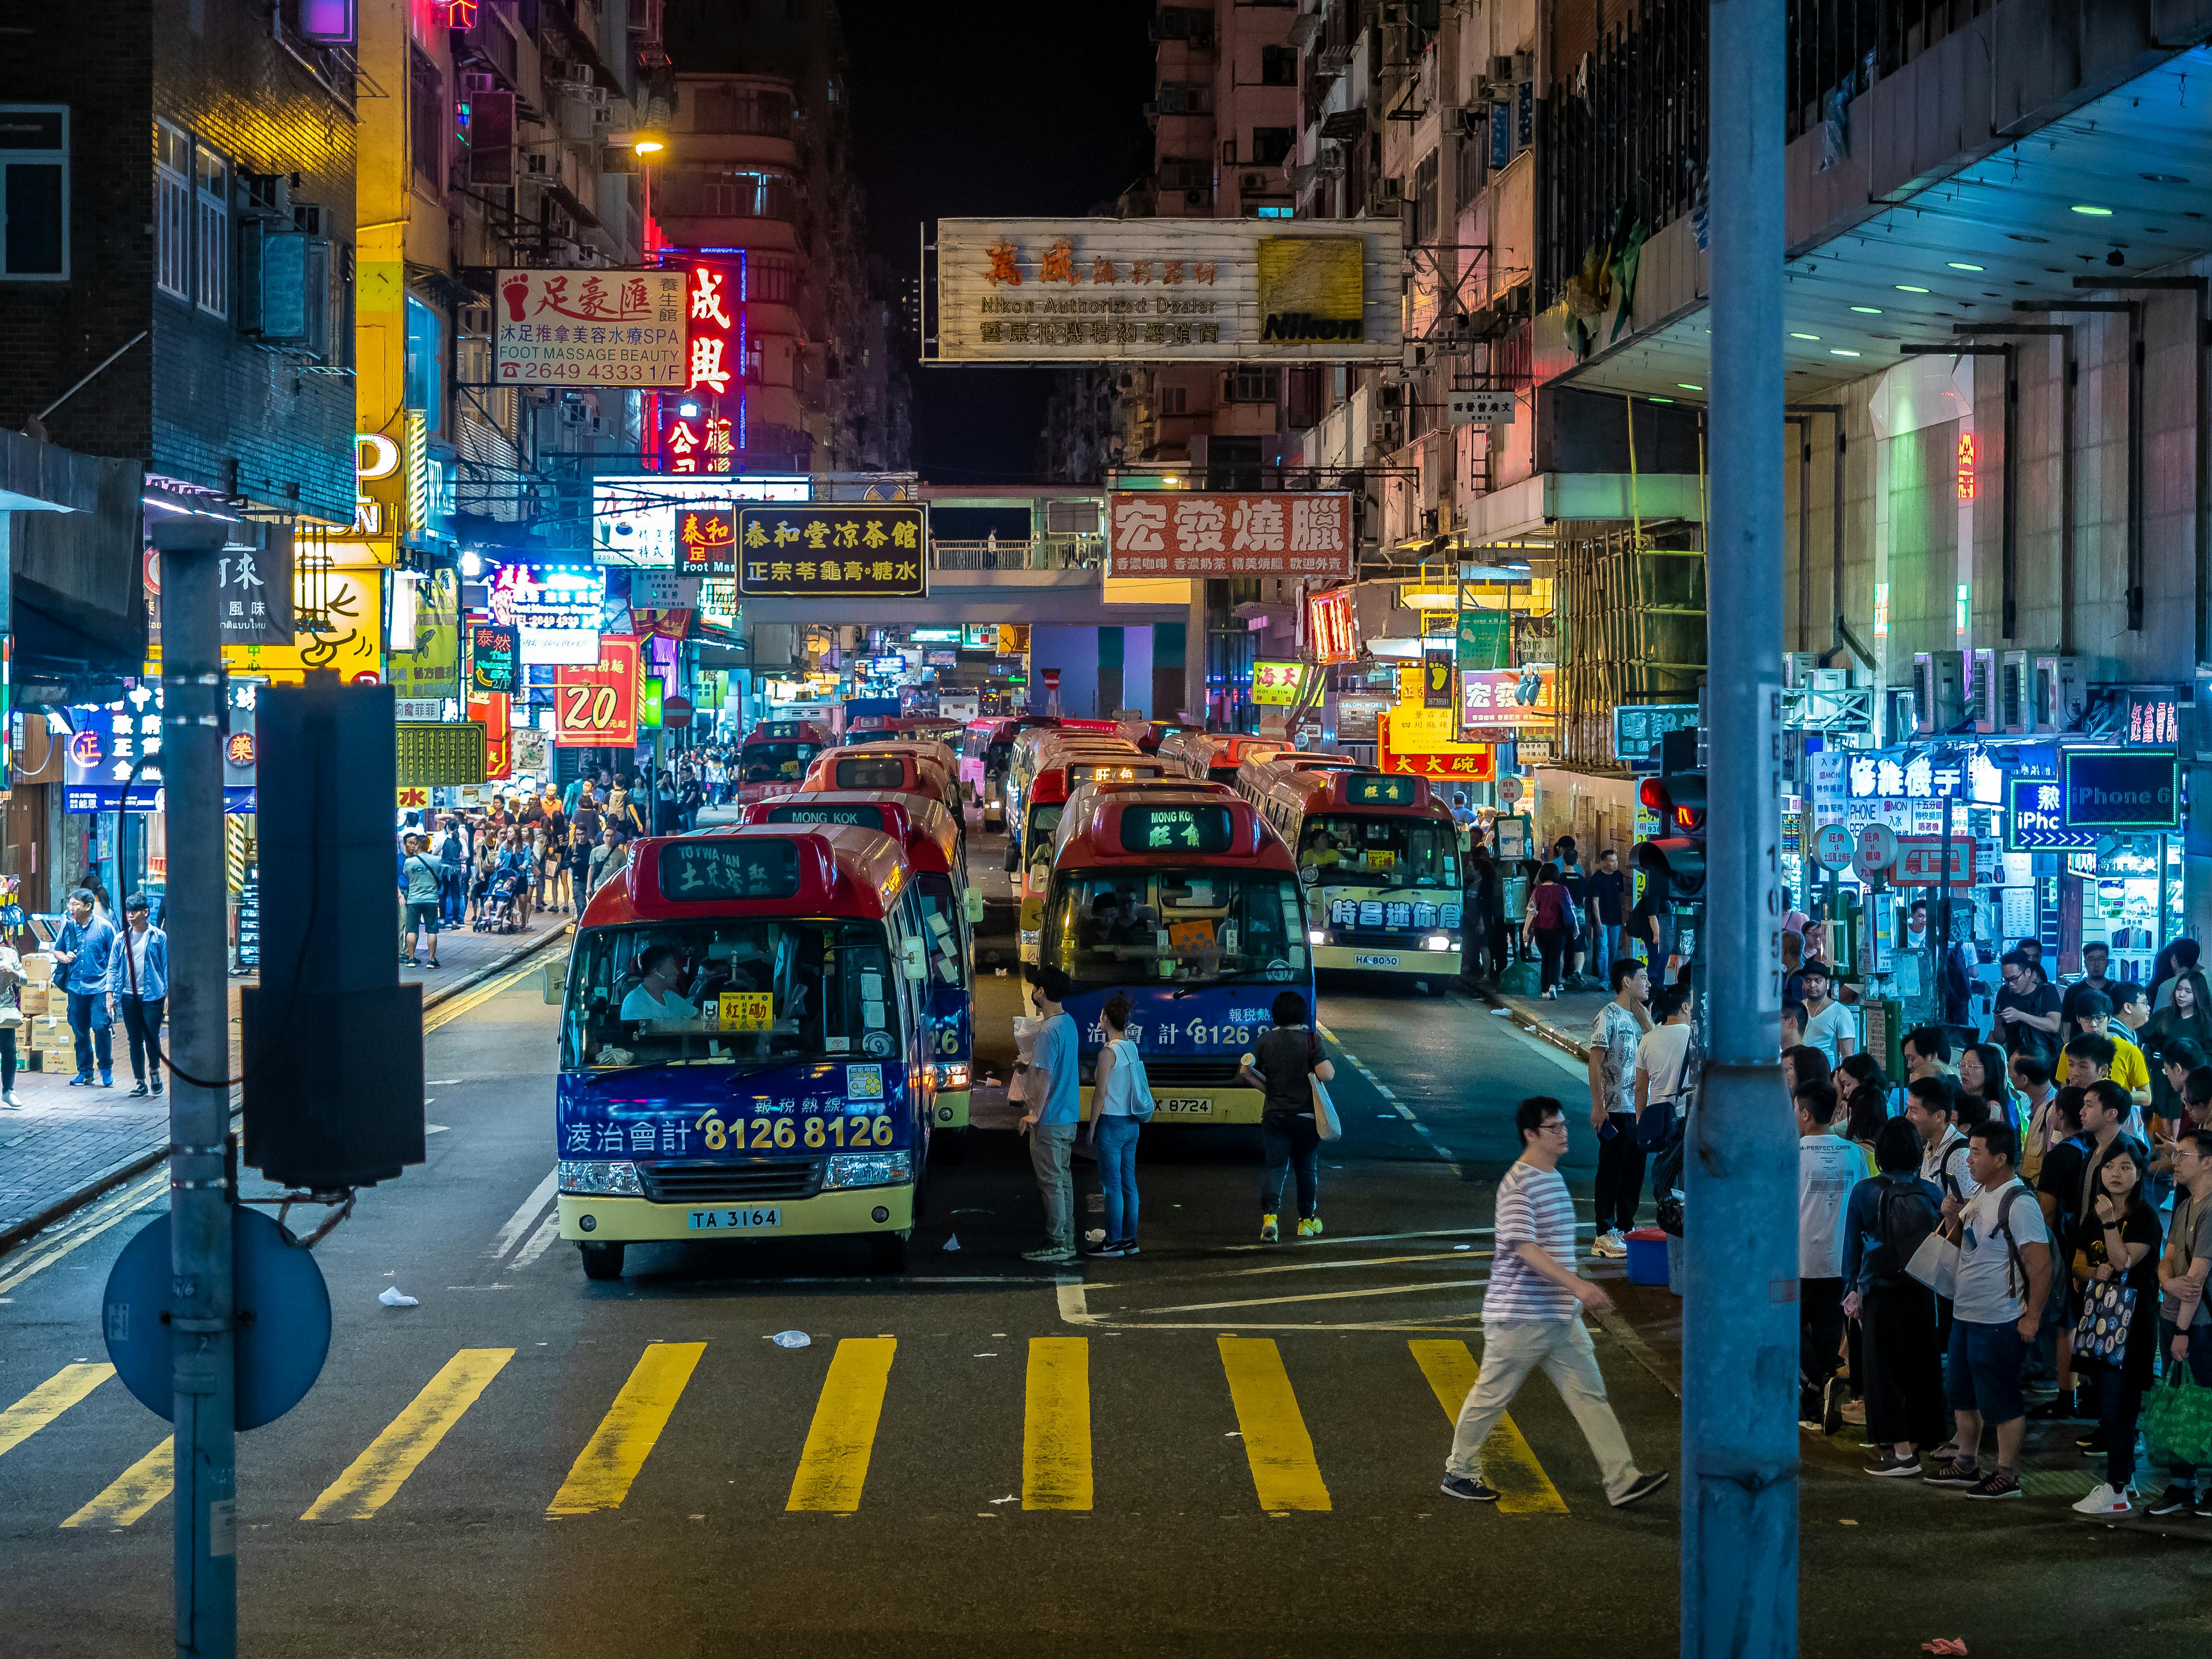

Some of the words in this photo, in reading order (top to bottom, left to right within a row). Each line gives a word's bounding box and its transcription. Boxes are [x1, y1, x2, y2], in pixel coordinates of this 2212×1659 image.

[659, 278, 678, 322] 養生館
[981, 297, 1034, 314] Nikon
[1044, 296, 1146, 314] Authorized
[1156, 297, 1216, 314] Dealer
[1263, 312, 1361, 340] Nikon
[500, 346, 539, 359] FOOT
[544, 348, 616, 361] MASSAGE
[620, 349, 679, 362] BEAUTY
[525, 363, 580, 379] 2649
[587, 364, 642, 380] 4333
[649, 365, 680, 381] 1/F
[682, 513, 729, 545] 泰和
[683, 562, 708, 572] Foot
[1116, 557, 1167, 570] 香濃咖啡
[1174, 557, 1225, 570] 香濃奶茶
[1290, 557, 1341, 570] 歡迎外賣
[477, 629, 511, 652] 泰然
[1256, 666, 1298, 688] 海天
[563, 686, 617, 730] 20
[77, 736, 102, 758] 正
[231, 735, 254, 761] 藥
[1394, 755, 1479, 773] 大大碗
[399, 788, 426, 806] 水
[2072, 787, 2151, 804] iPhone
[2158, 787, 2170, 804] 6
[792, 812, 827, 823] MONG
[834, 813, 857, 824] KOK
[1151, 812, 1177, 823] MONG
[1850, 804, 1876, 820] PHONE
[1828, 833, 1844, 843] 旺角
[1865, 832, 1880, 841] 旺角
[1332, 901, 1460, 928] 時昌迷你倉
[1194, 1025, 1249, 1045] 8126
[1169, 1100, 1208, 1112] 8724
[565, 1121, 690, 1152] 凌治會計
[705, 1118, 795, 1150] 8126
[803, 1115, 893, 1147] 8126
[693, 1212, 717, 1228] TA
[727, 1209, 777, 1227] 3164
